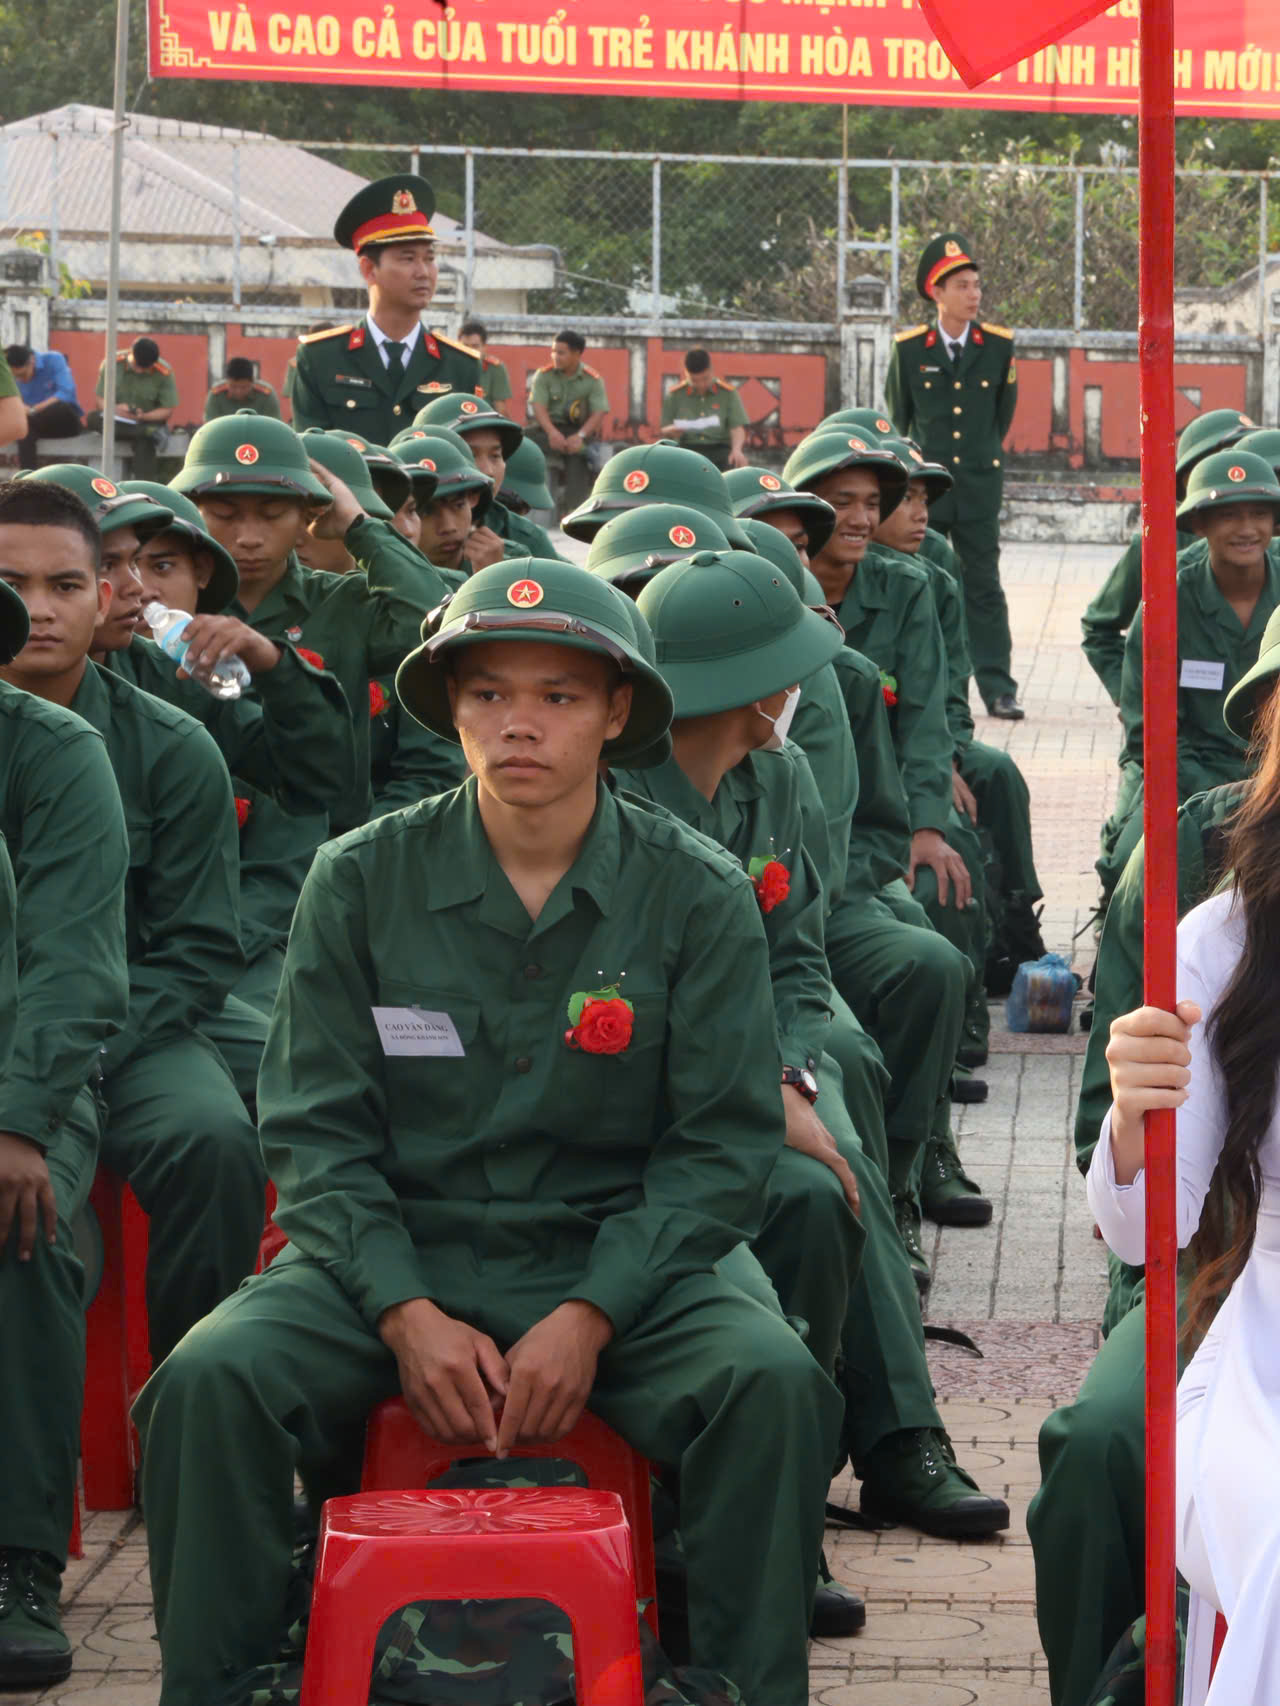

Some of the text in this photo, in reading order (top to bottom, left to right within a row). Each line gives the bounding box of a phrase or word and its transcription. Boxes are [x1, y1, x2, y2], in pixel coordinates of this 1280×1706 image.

[208, 3, 256, 52] VÀ
[268, 13, 340, 56] CAO
[352, 4, 402, 59] CẢ
[412, 7, 487, 62] CỦA
[496, 9, 577, 66] TUỔI
[588, 15, 654, 69] TRẺ
[665, 23, 789, 74] KHÁNH
[800, 26, 873, 77] HÒA
[1107, 39, 1192, 89] HÌH
[385, 1023, 404, 1031] CAO
